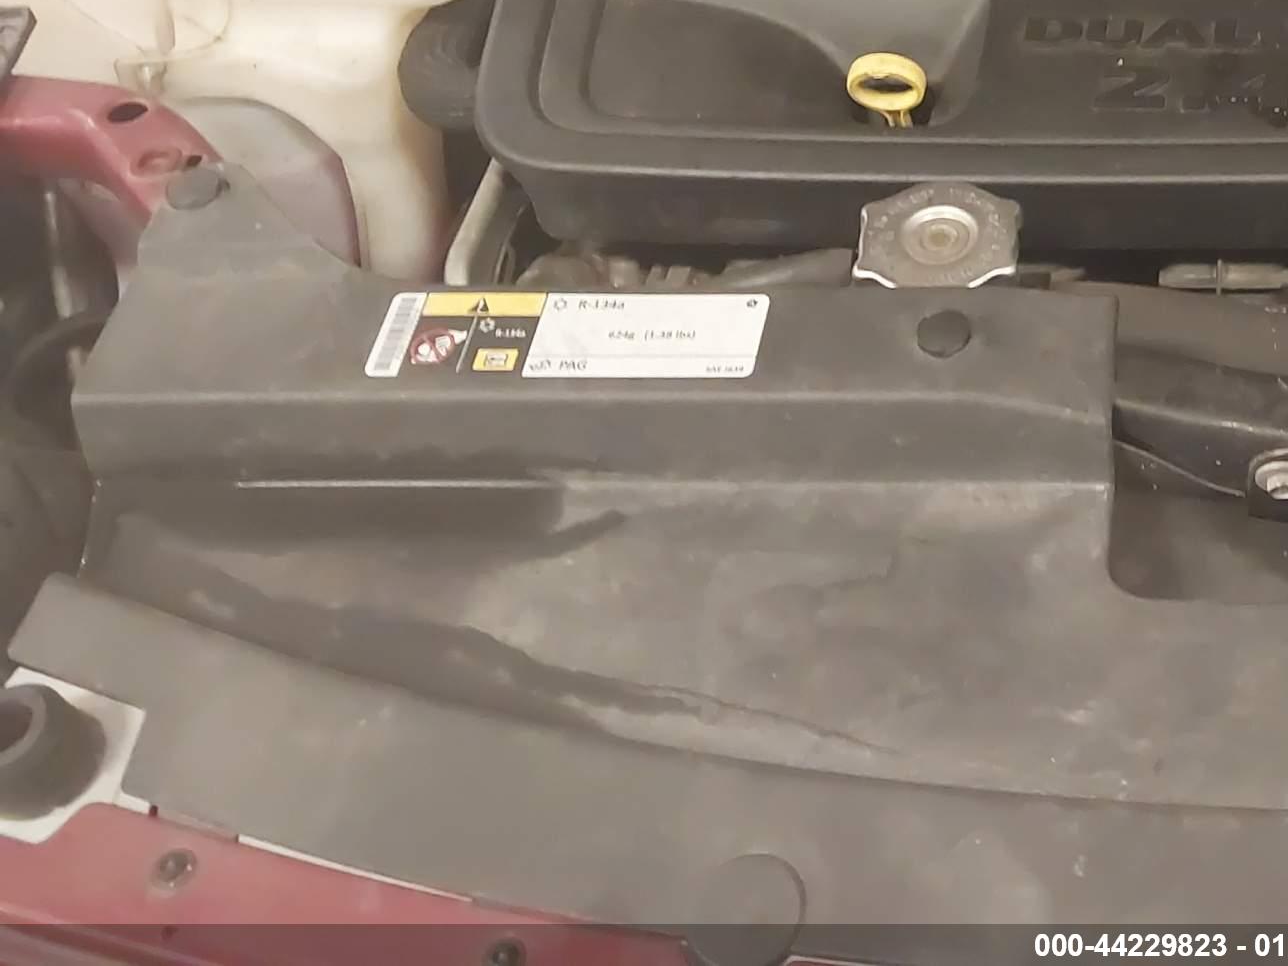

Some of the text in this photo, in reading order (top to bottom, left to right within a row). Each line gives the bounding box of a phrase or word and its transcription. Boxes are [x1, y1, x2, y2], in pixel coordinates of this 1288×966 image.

[1022, 17, 1260, 49] DUAL
[578, 299, 626, 311] R-134a
[558, 360, 588, 371] PAG
